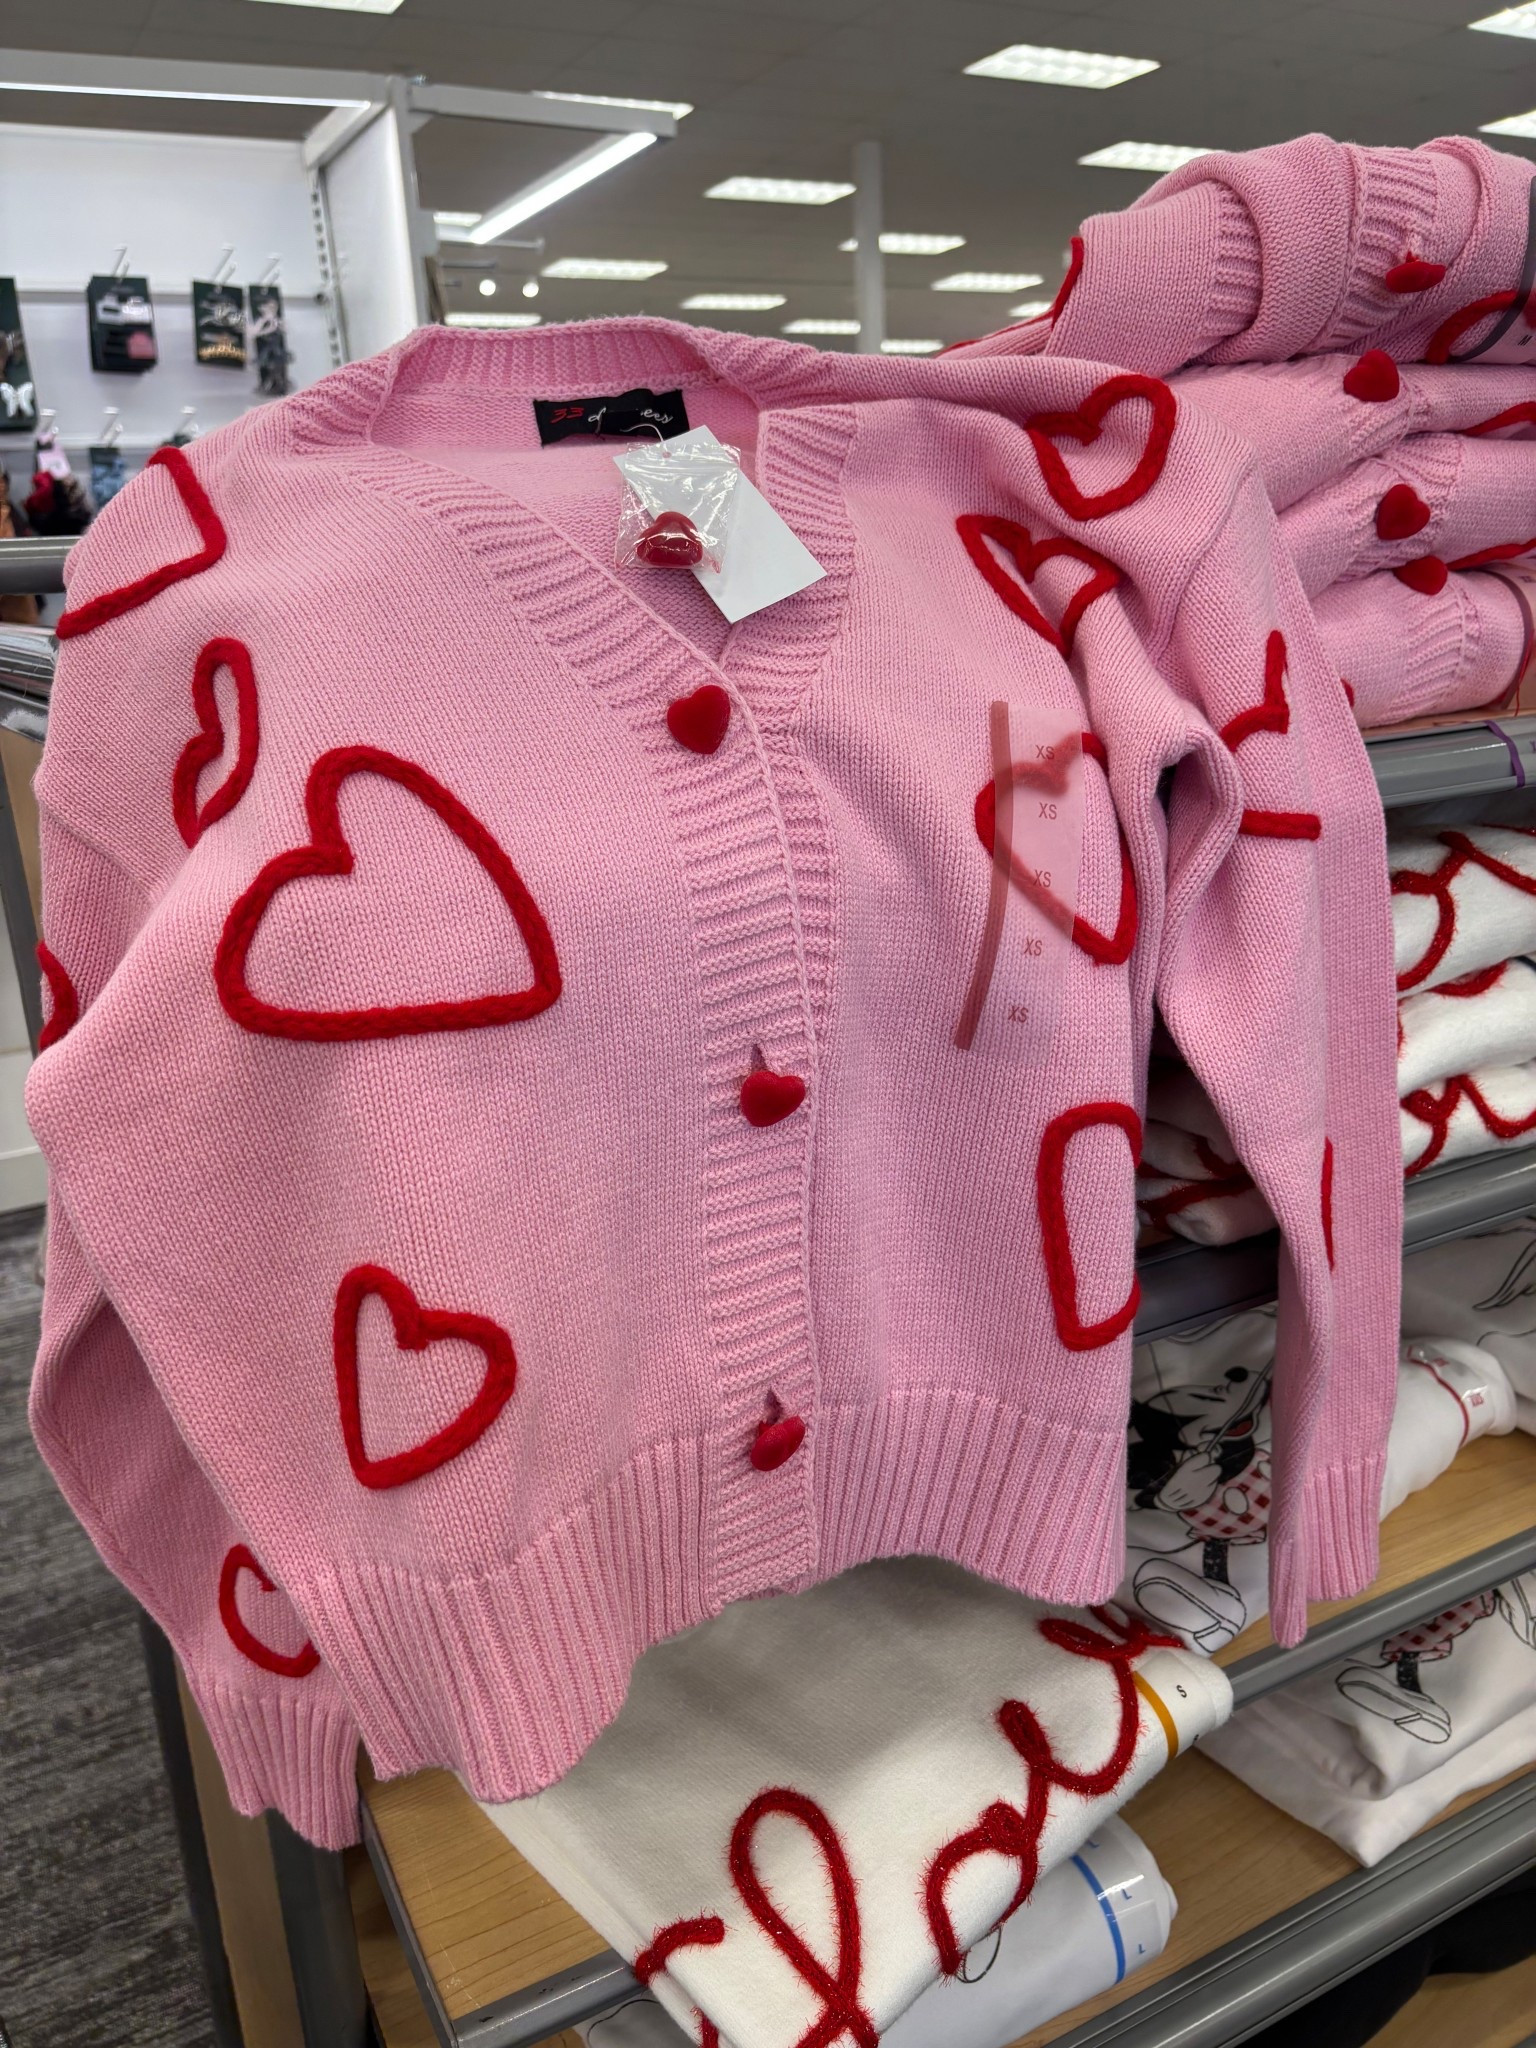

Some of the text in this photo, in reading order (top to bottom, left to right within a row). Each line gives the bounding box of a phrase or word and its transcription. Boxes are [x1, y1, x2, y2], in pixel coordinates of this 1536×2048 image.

[551, 407, 585, 424] 33
[1035, 744, 1055, 760] XS
[1039, 802, 1058, 820] XS
[1033, 869, 1052, 888] XS
[1024, 938, 1043, 957] XS
[1008, 1005, 1029, 1024] XS
[1176, 1684, 1187, 1698] S
[1121, 1888, 1132, 1901] L
[1138, 1943, 1146, 1955] L
